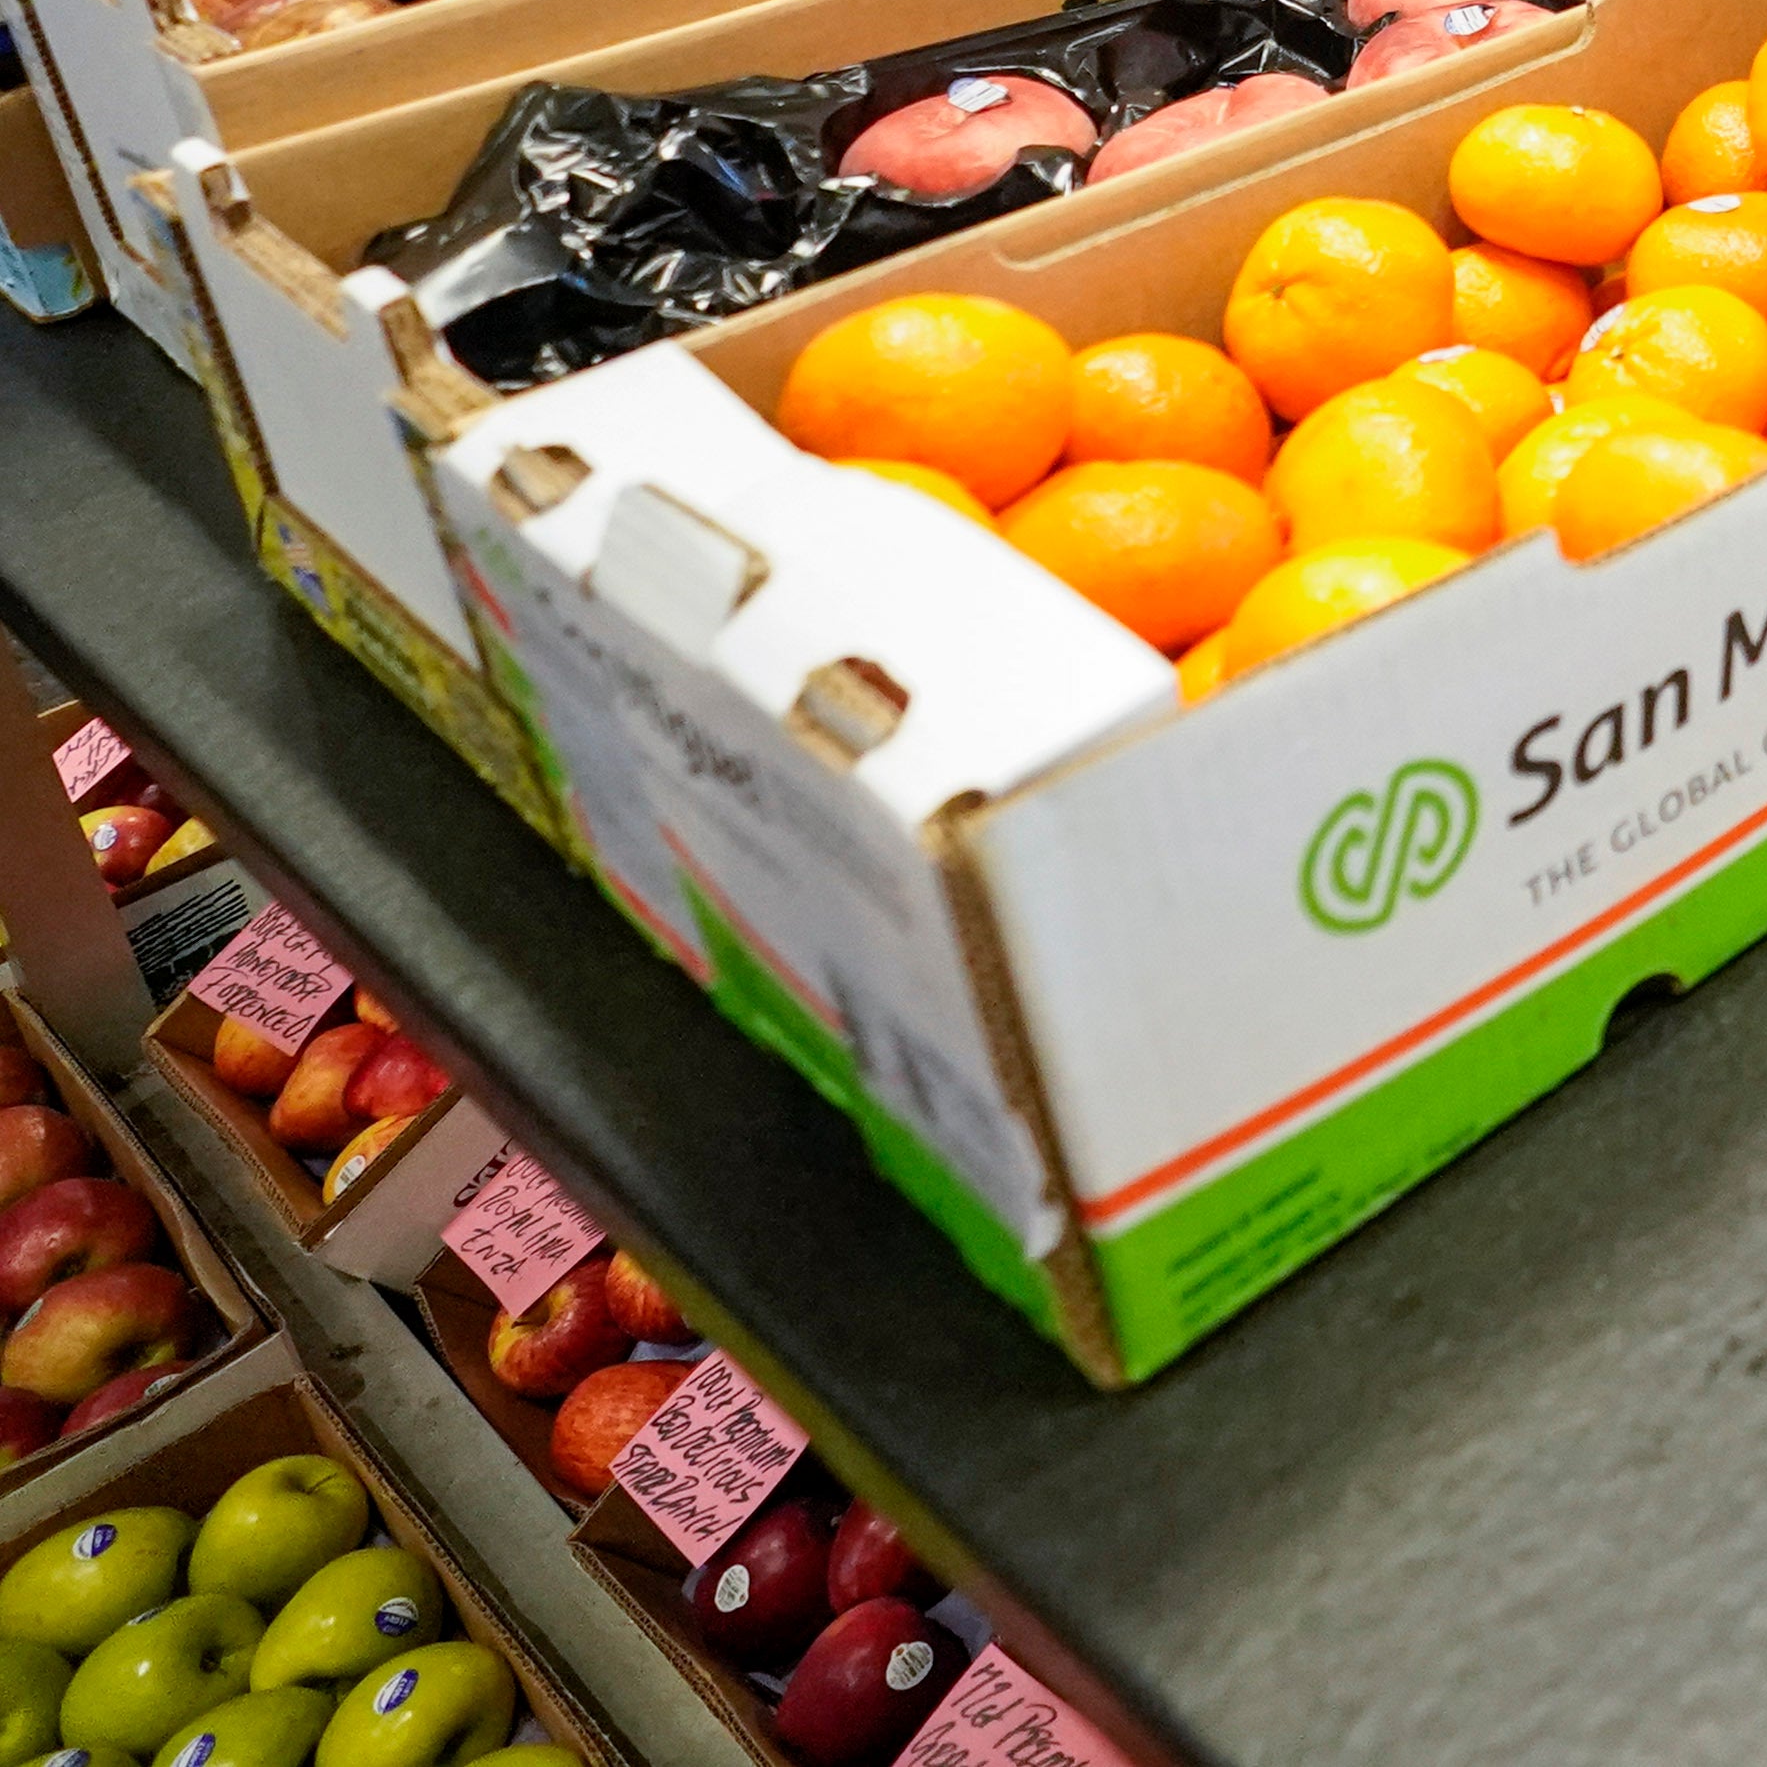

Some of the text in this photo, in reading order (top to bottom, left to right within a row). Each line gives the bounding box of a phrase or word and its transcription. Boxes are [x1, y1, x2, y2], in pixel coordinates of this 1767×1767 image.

[1507, 666, 1690, 828] San
[1524, 840, 1598, 907] THE
[1609, 750, 1753, 855] GLOBAL
